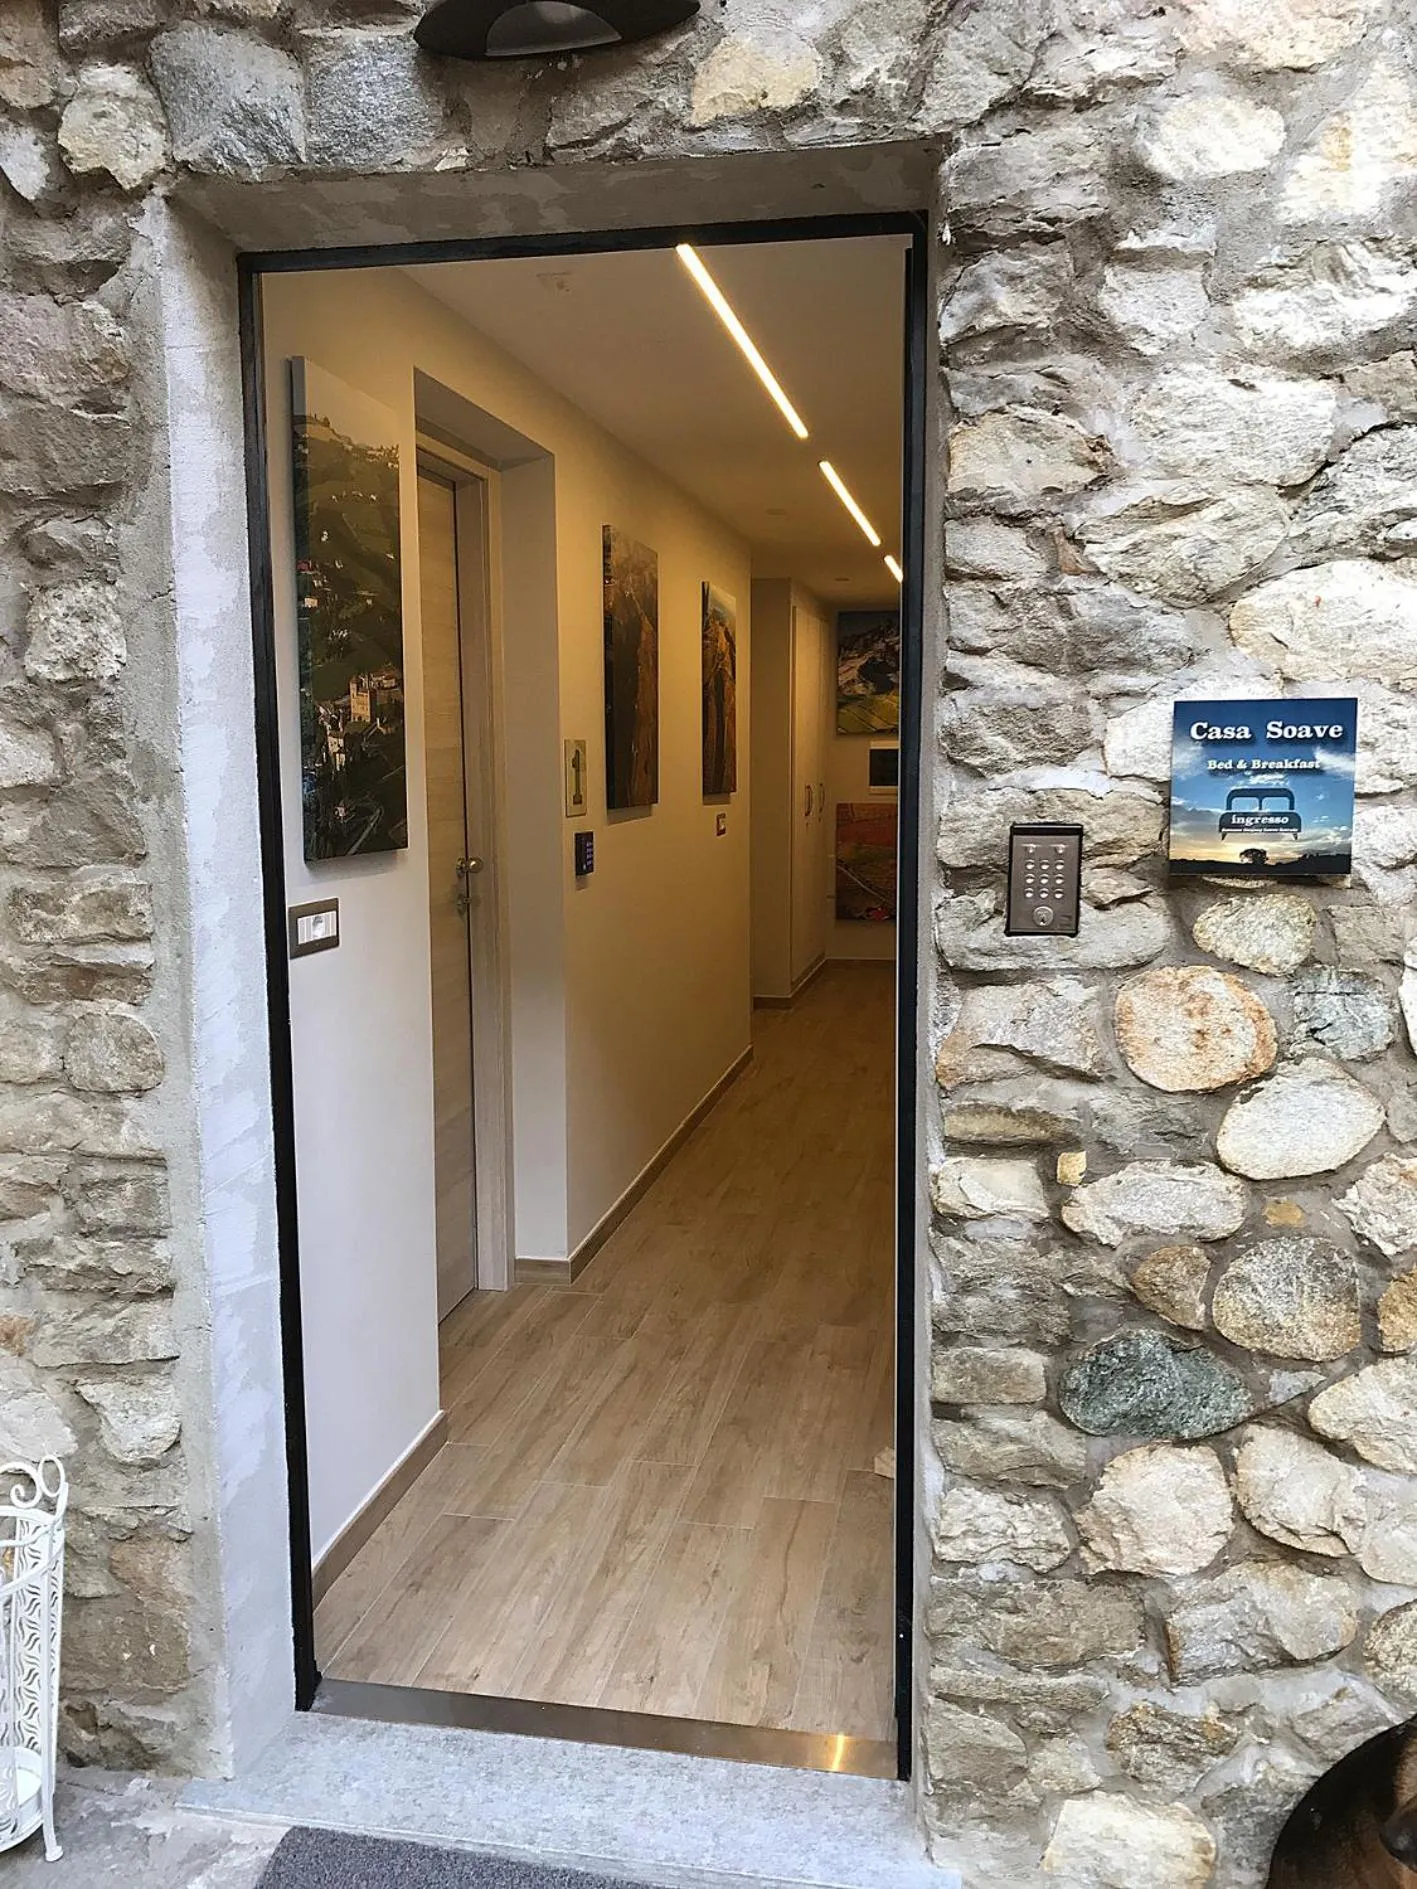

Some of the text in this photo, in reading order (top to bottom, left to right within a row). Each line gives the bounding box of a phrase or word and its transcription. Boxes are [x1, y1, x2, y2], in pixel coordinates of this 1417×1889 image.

[1190, 720, 1344, 740] Casa Soave
[1207, 758, 1321, 770] Bed & Breakfast
